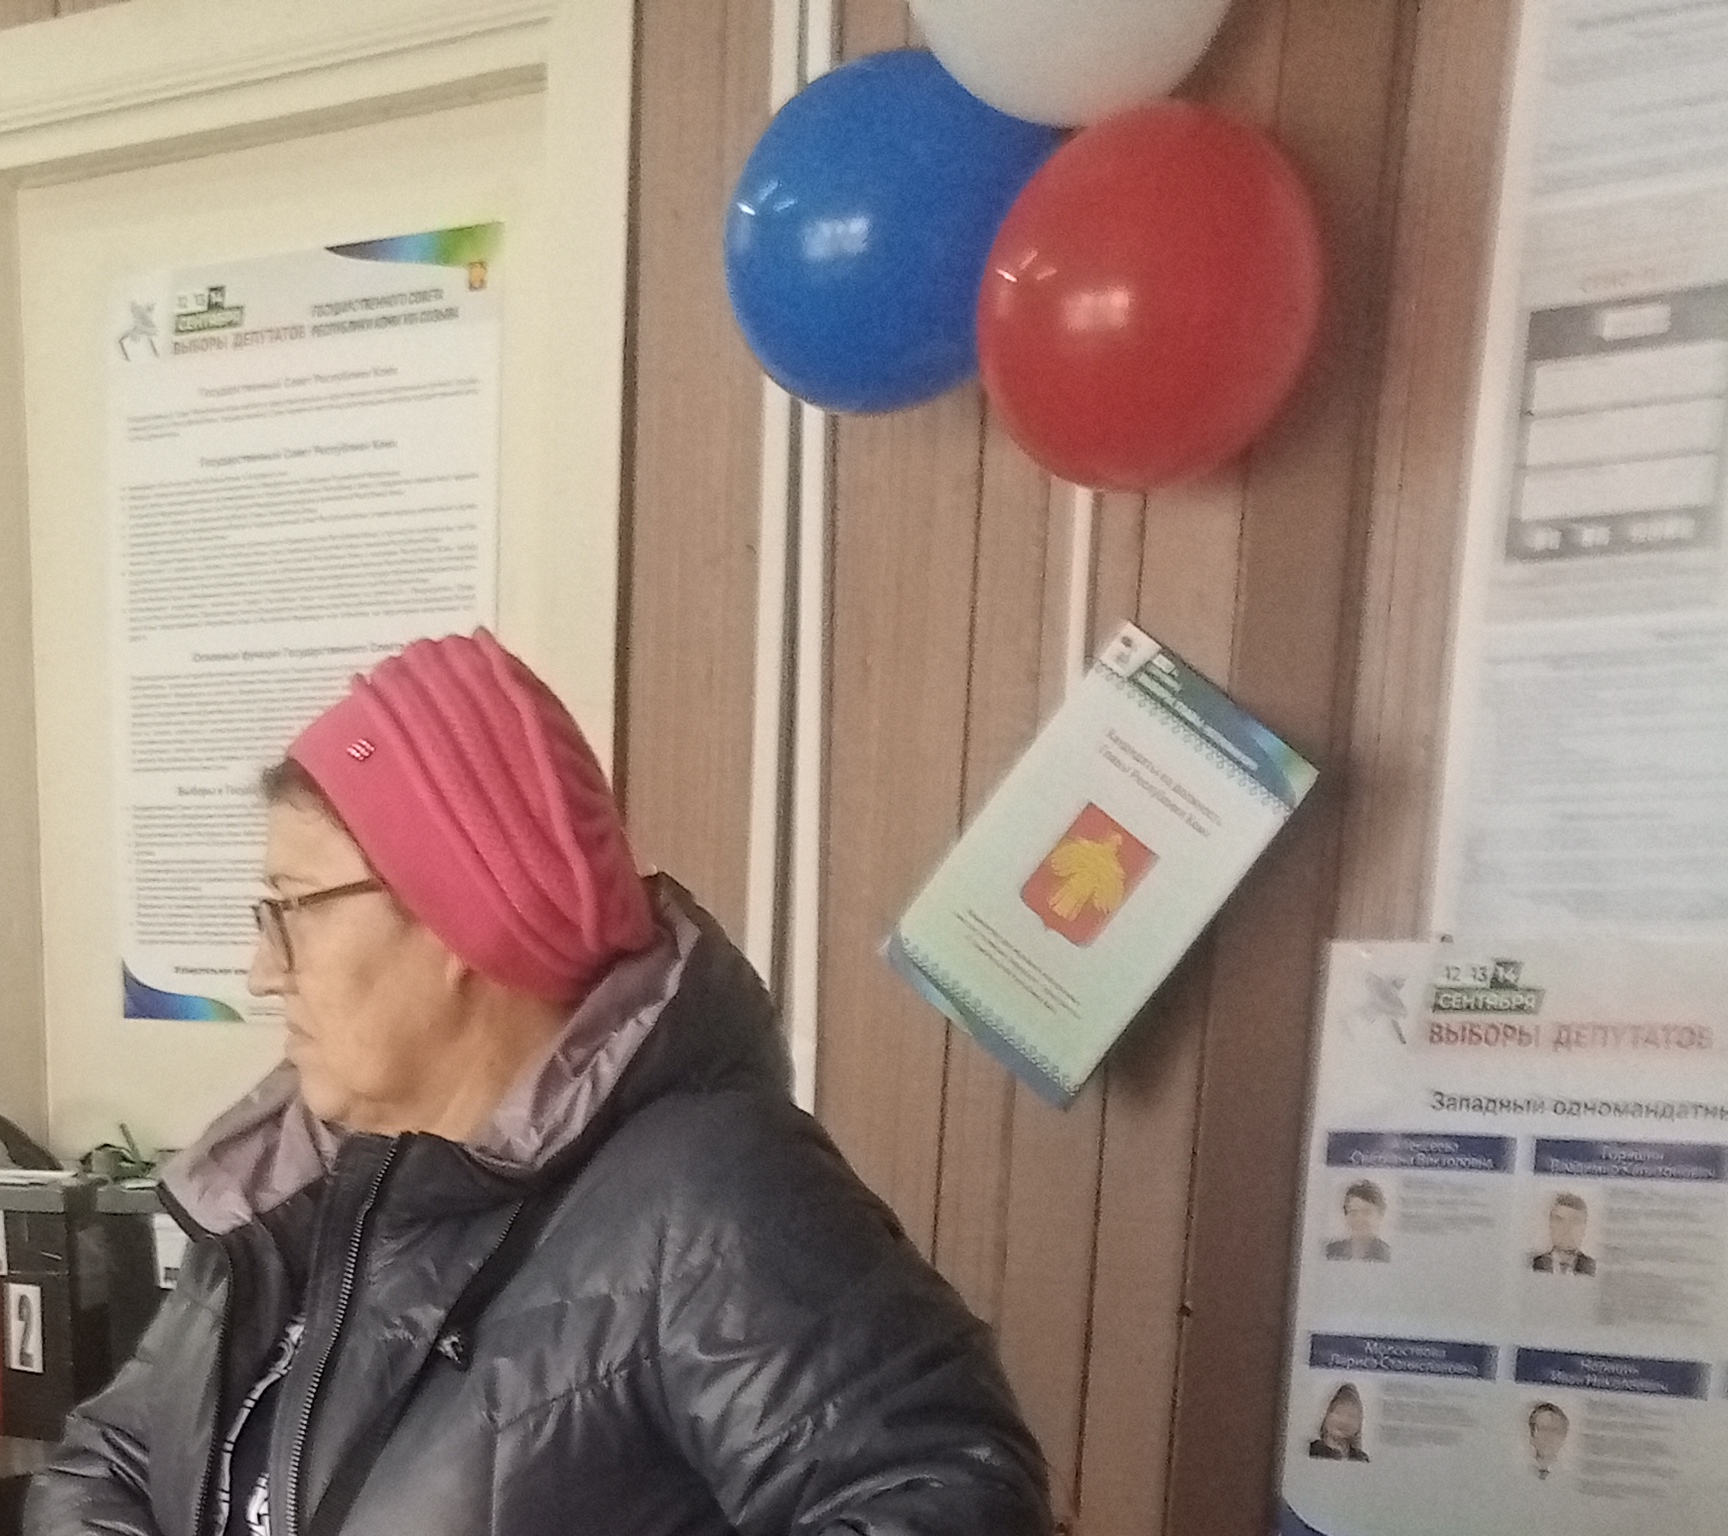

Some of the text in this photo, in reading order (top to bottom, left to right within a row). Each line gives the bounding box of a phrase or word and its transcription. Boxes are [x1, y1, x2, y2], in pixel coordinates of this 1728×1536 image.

[172, 324, 304, 355] ВЫБОРЫ ДЕПУТАТОВ
[1444, 966, 1460, 982] 12
[1471, 967, 1487, 983] 13
[1437, 993, 1536, 1010] СЕНТЯБРЯ
[1429, 1023, 1714, 1051] ВЫБОРЫ ДЕПУТАТОВ
[1432, 1092, 1546, 1116] Западный
[18, 1294, 34, 1365] 2
